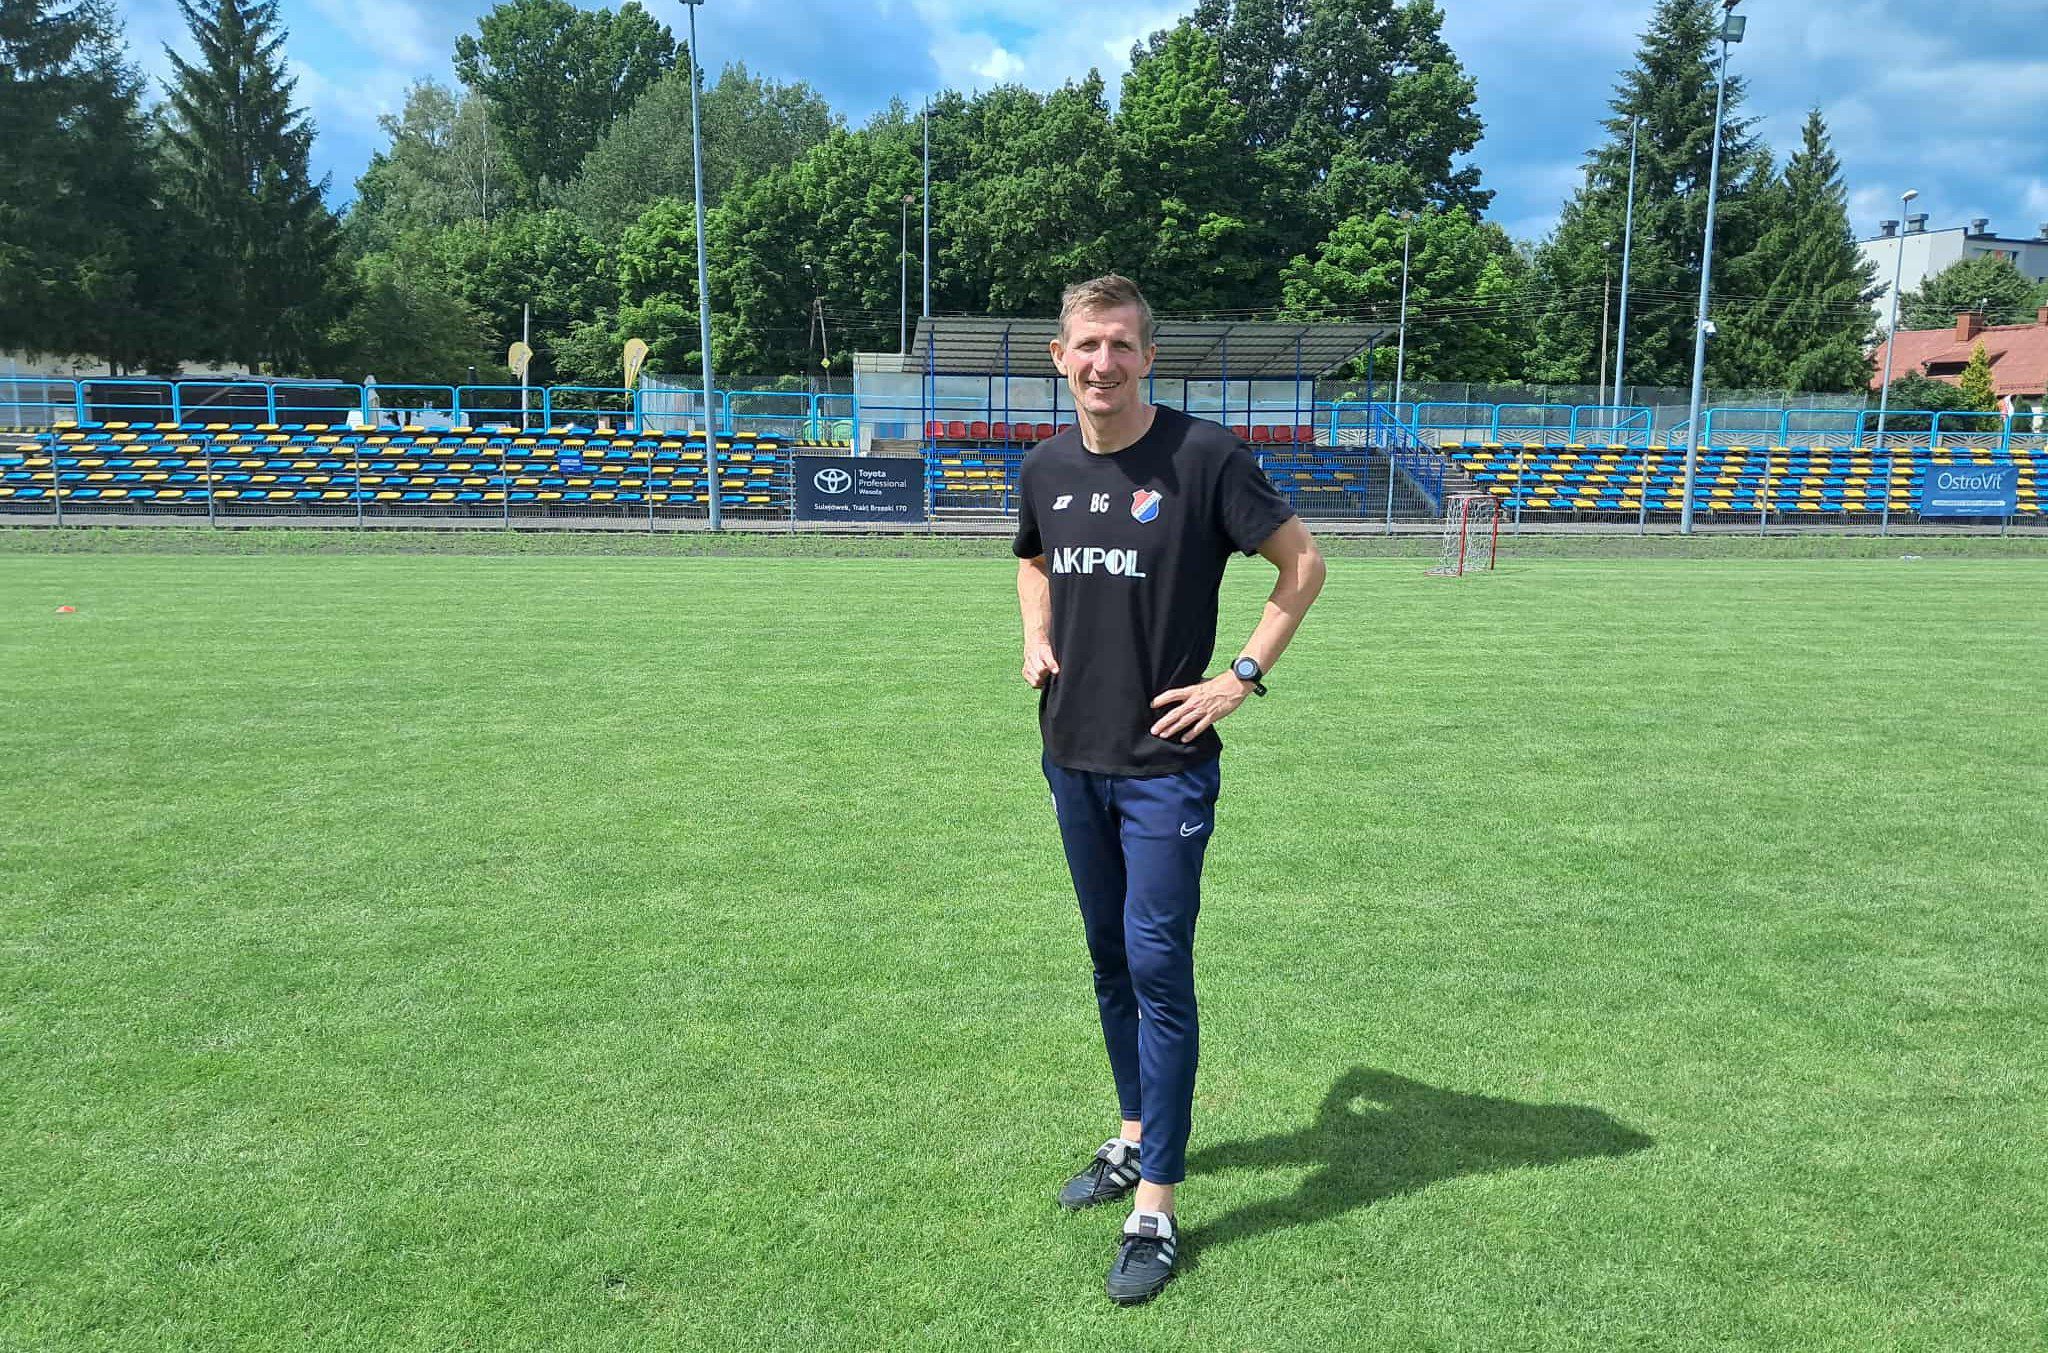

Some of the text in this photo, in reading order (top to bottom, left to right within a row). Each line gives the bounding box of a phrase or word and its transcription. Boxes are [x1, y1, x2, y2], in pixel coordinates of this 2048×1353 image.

[859, 469, 886, 479] Toyota
[859, 478, 907, 488] Professional
[1938, 472, 2003, 490] OstroVit
[1089, 493, 1110, 513] BG
[1052, 547, 1147, 578] AKPOL
